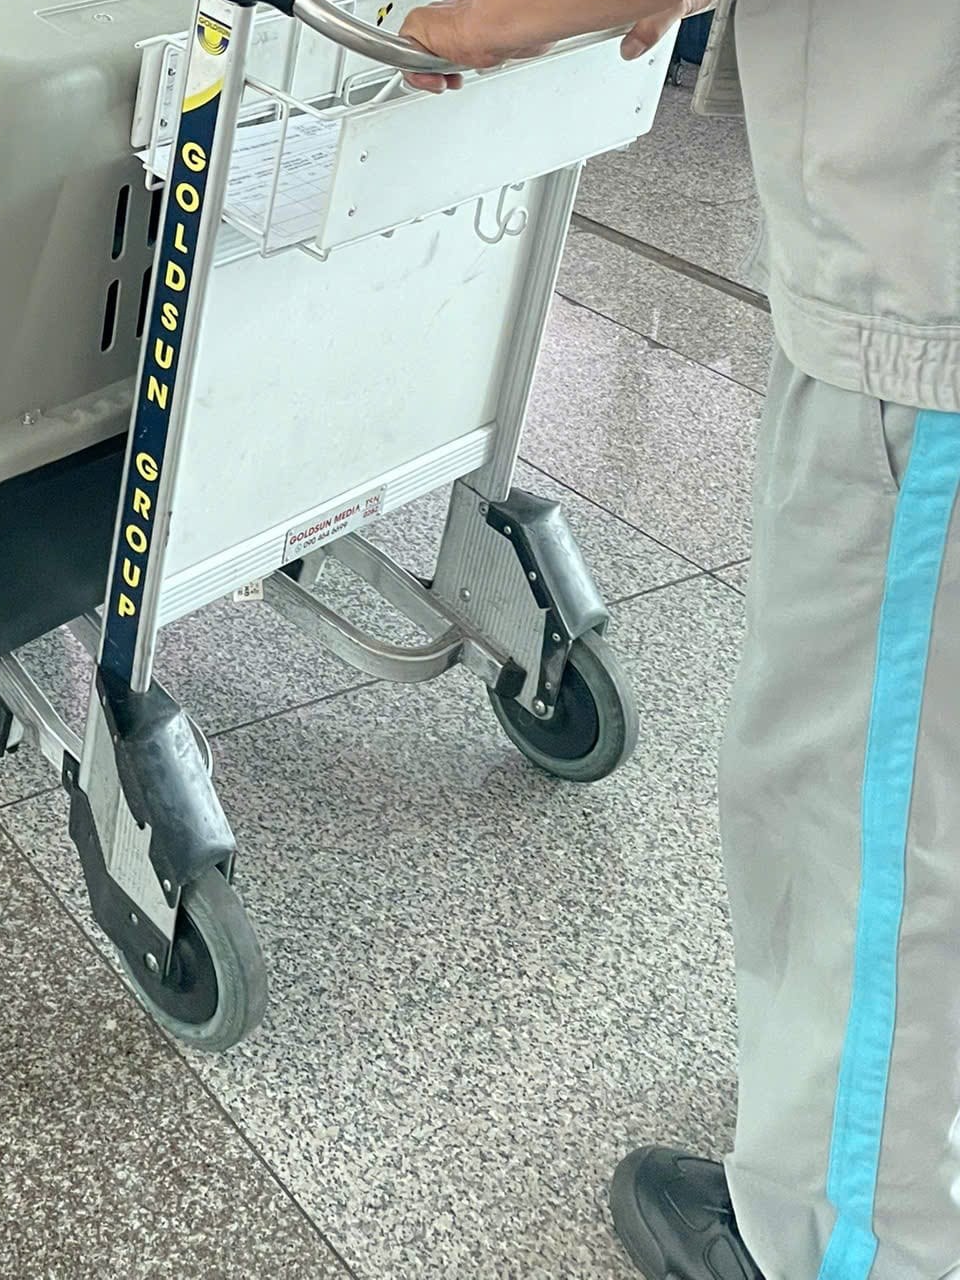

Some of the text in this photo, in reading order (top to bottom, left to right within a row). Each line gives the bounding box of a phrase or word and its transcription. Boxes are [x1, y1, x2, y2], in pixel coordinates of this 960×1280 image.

[116, 141, 207, 618] GOLDSUN GROUP
[289, 504, 361, 545] GOLDSUN MEDIA
